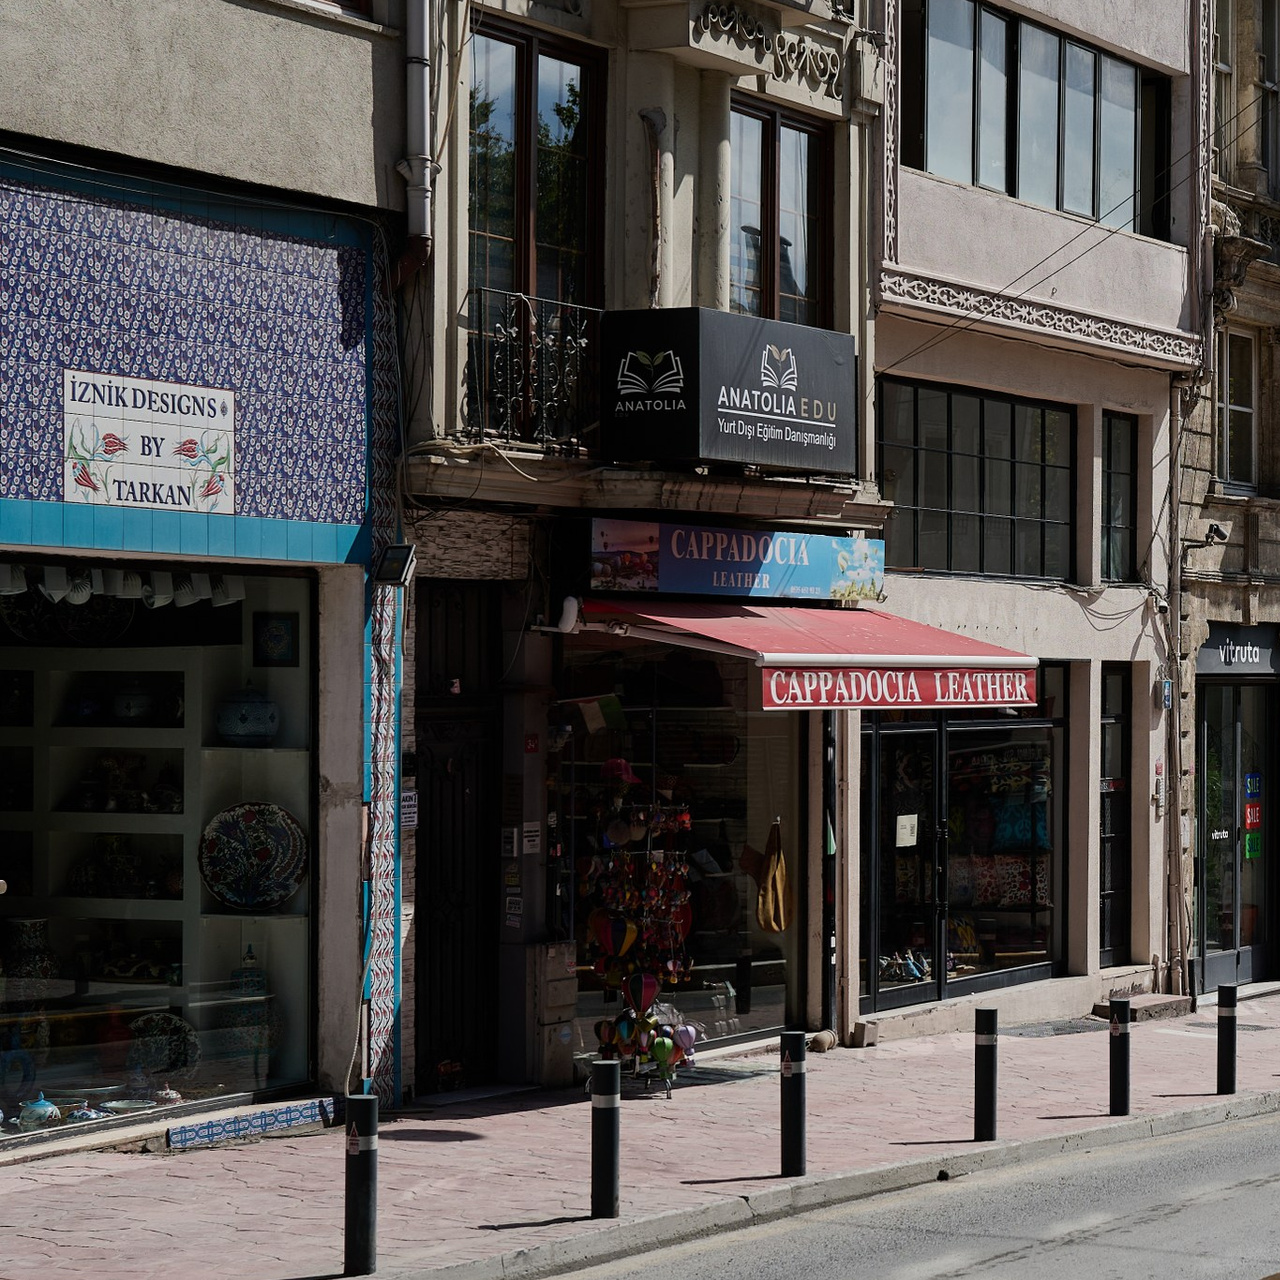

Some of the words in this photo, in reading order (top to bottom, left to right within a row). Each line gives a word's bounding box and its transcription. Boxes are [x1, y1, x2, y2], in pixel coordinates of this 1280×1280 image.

[70, 375, 130, 408] İZNİK
[131, 387, 217, 418] DESIGNS
[614, 398, 687, 413] ANATOLIA
[717, 385, 797, 416] ANATOLIA
[801, 397, 836, 421] EDU
[717, 417, 737, 434] Yurt
[737, 420, 755, 439] Dışı
[757, 423, 783, 441] Eğitim
[785, 426, 836, 450] Danışmanlığı
[140, 435, 165, 458] BY
[112, 478, 191, 506] TARKAN
[671, 529, 810, 566] CAPPADOCIA
[712, 571, 770, 589] LEATHER
[1219, 637, 1260, 664] vitruta
[769, 669, 922, 704] CAPPADOCIA
[934, 671, 1029, 702] LEATHER
[1246, 777, 1260, 793] SALE
[1246, 807, 1260, 824] SALE
[1211, 829, 1229, 840] vitruta
[1247, 836, 1260, 853] SALE
